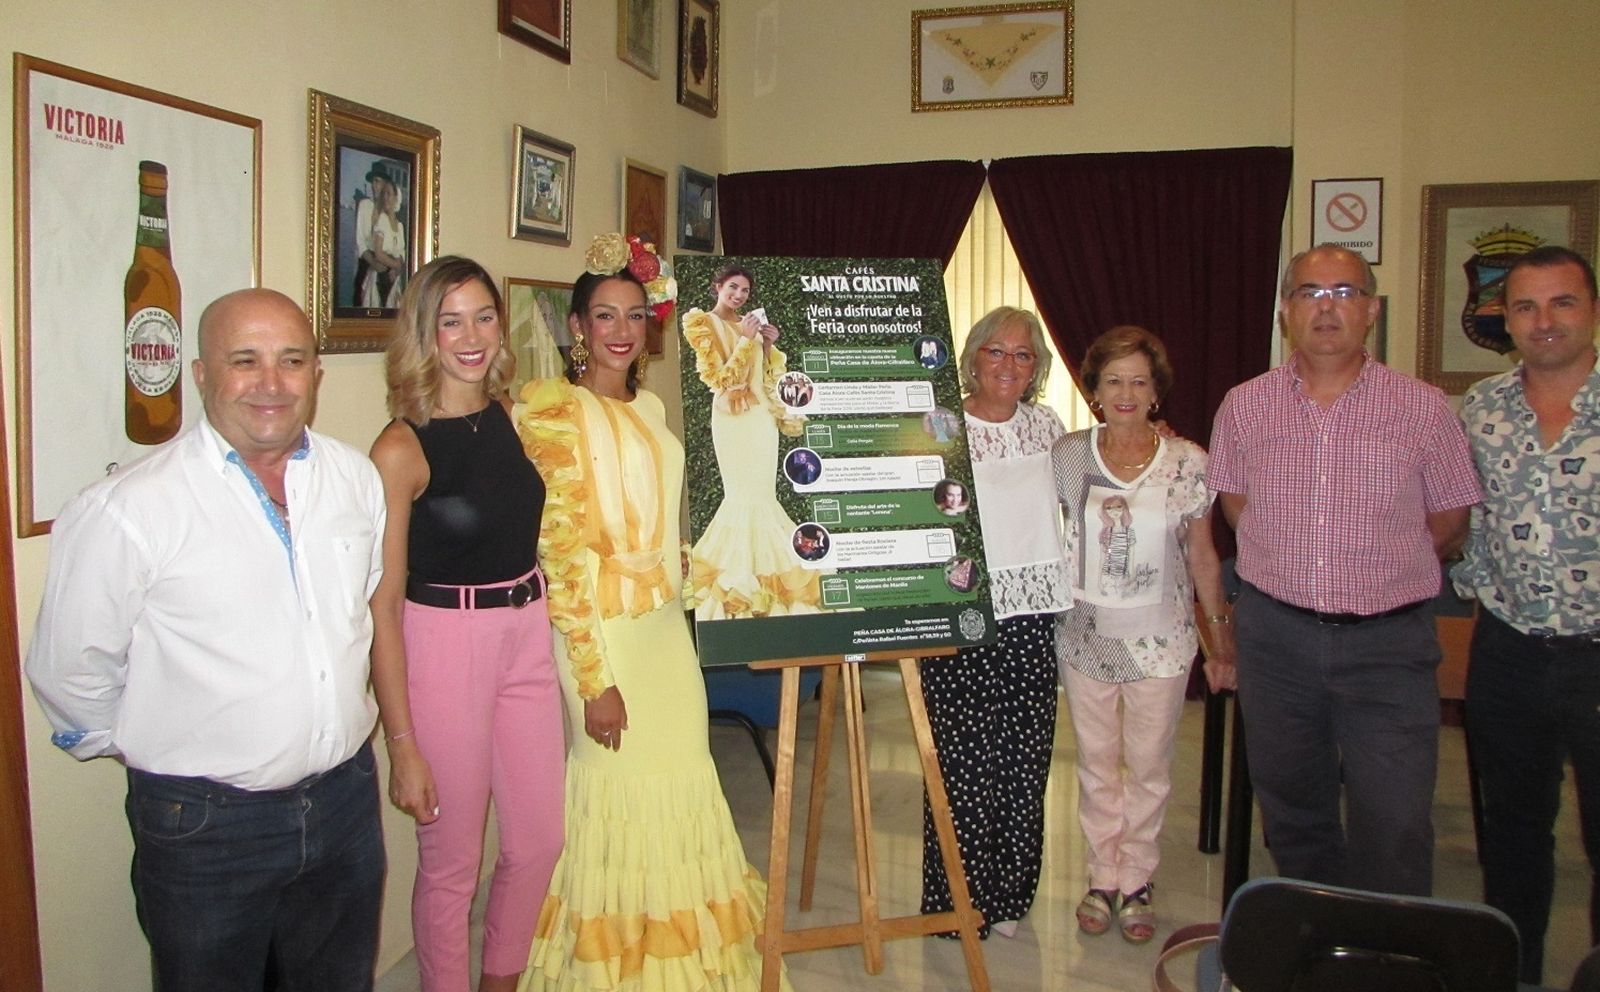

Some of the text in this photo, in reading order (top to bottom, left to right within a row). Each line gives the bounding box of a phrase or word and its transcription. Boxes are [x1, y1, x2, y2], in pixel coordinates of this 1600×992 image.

[44, 103, 124, 145] VICTORIA
[96, 142, 114, 150] 1928
[140, 215, 168, 229] VICTORIA
[845, 266, 875, 275] CAFÉS
[800, 276, 920, 292] SANTA CRISTINA
[807, 304, 922, 320] ¡Ven a disfrutar de la
[811, 318, 922, 333] Feria con nosotros!
[130, 343, 176, 361] VICTORIA
